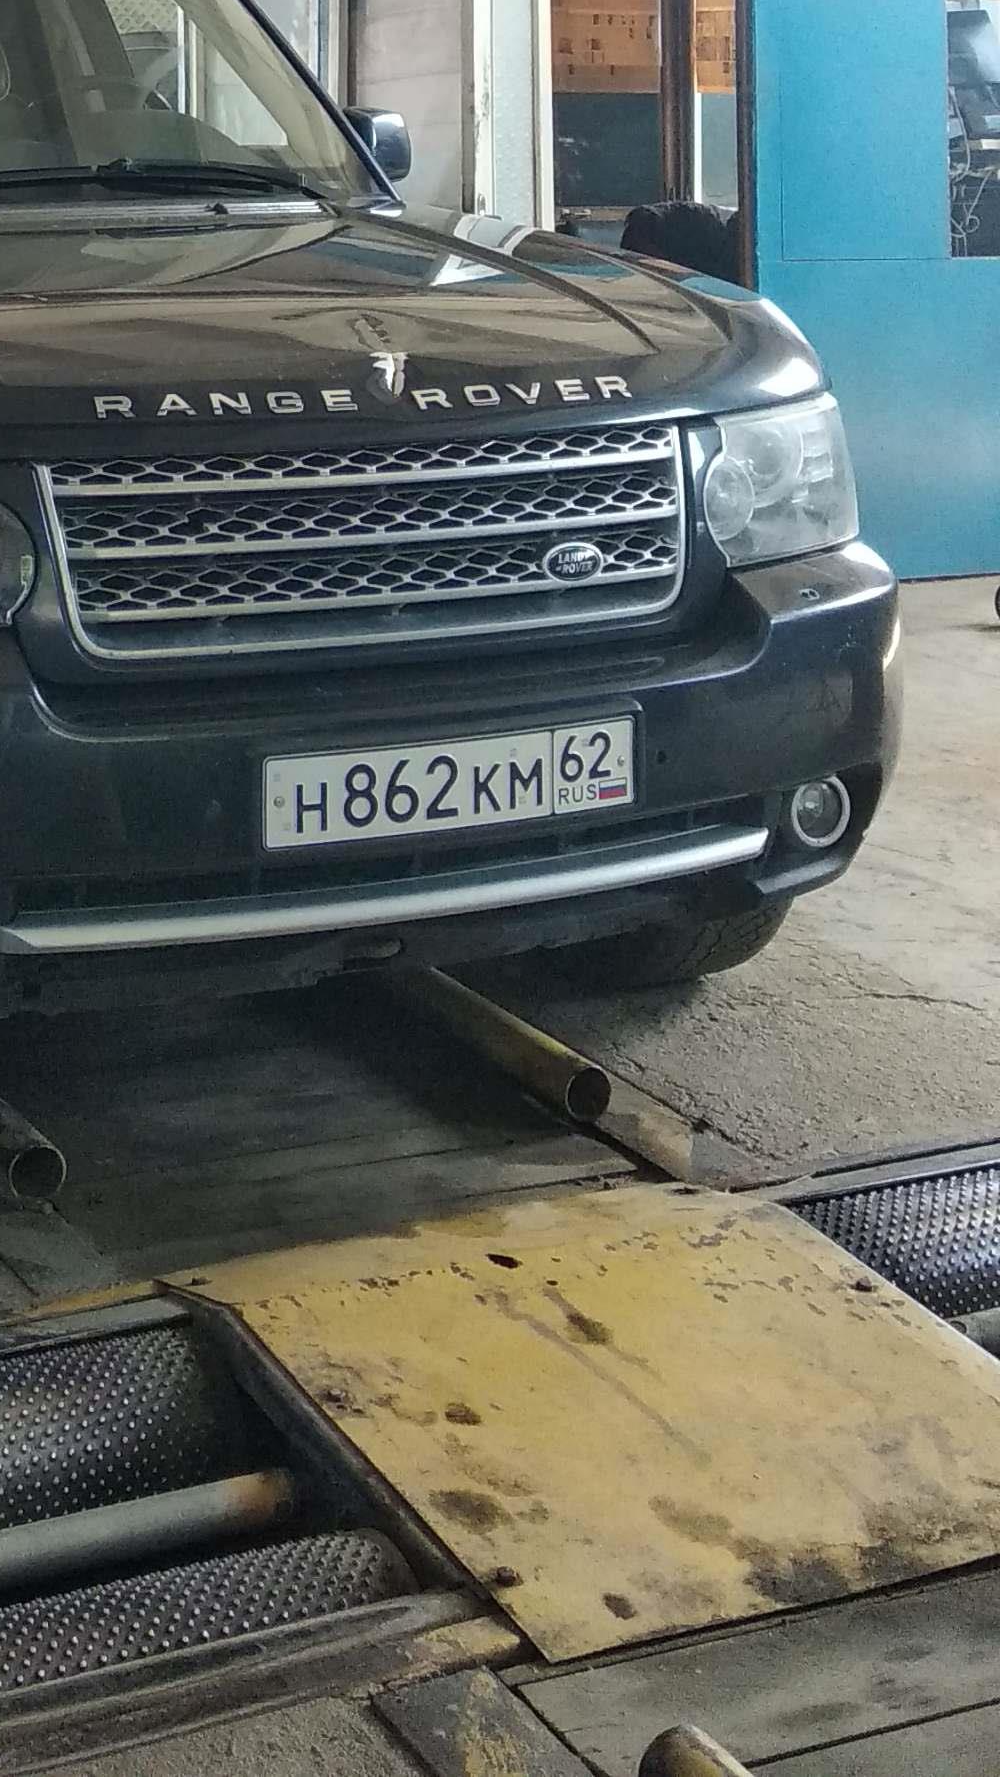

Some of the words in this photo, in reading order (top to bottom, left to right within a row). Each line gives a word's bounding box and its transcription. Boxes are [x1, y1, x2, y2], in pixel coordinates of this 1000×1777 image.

[94, 389, 358, 420] RANGE
[412, 375, 633, 411] ROVER
[296, 755, 543, 834] Н862КМ
[559, 731, 612, 784] 62
[558, 783, 598, 805] RUS
